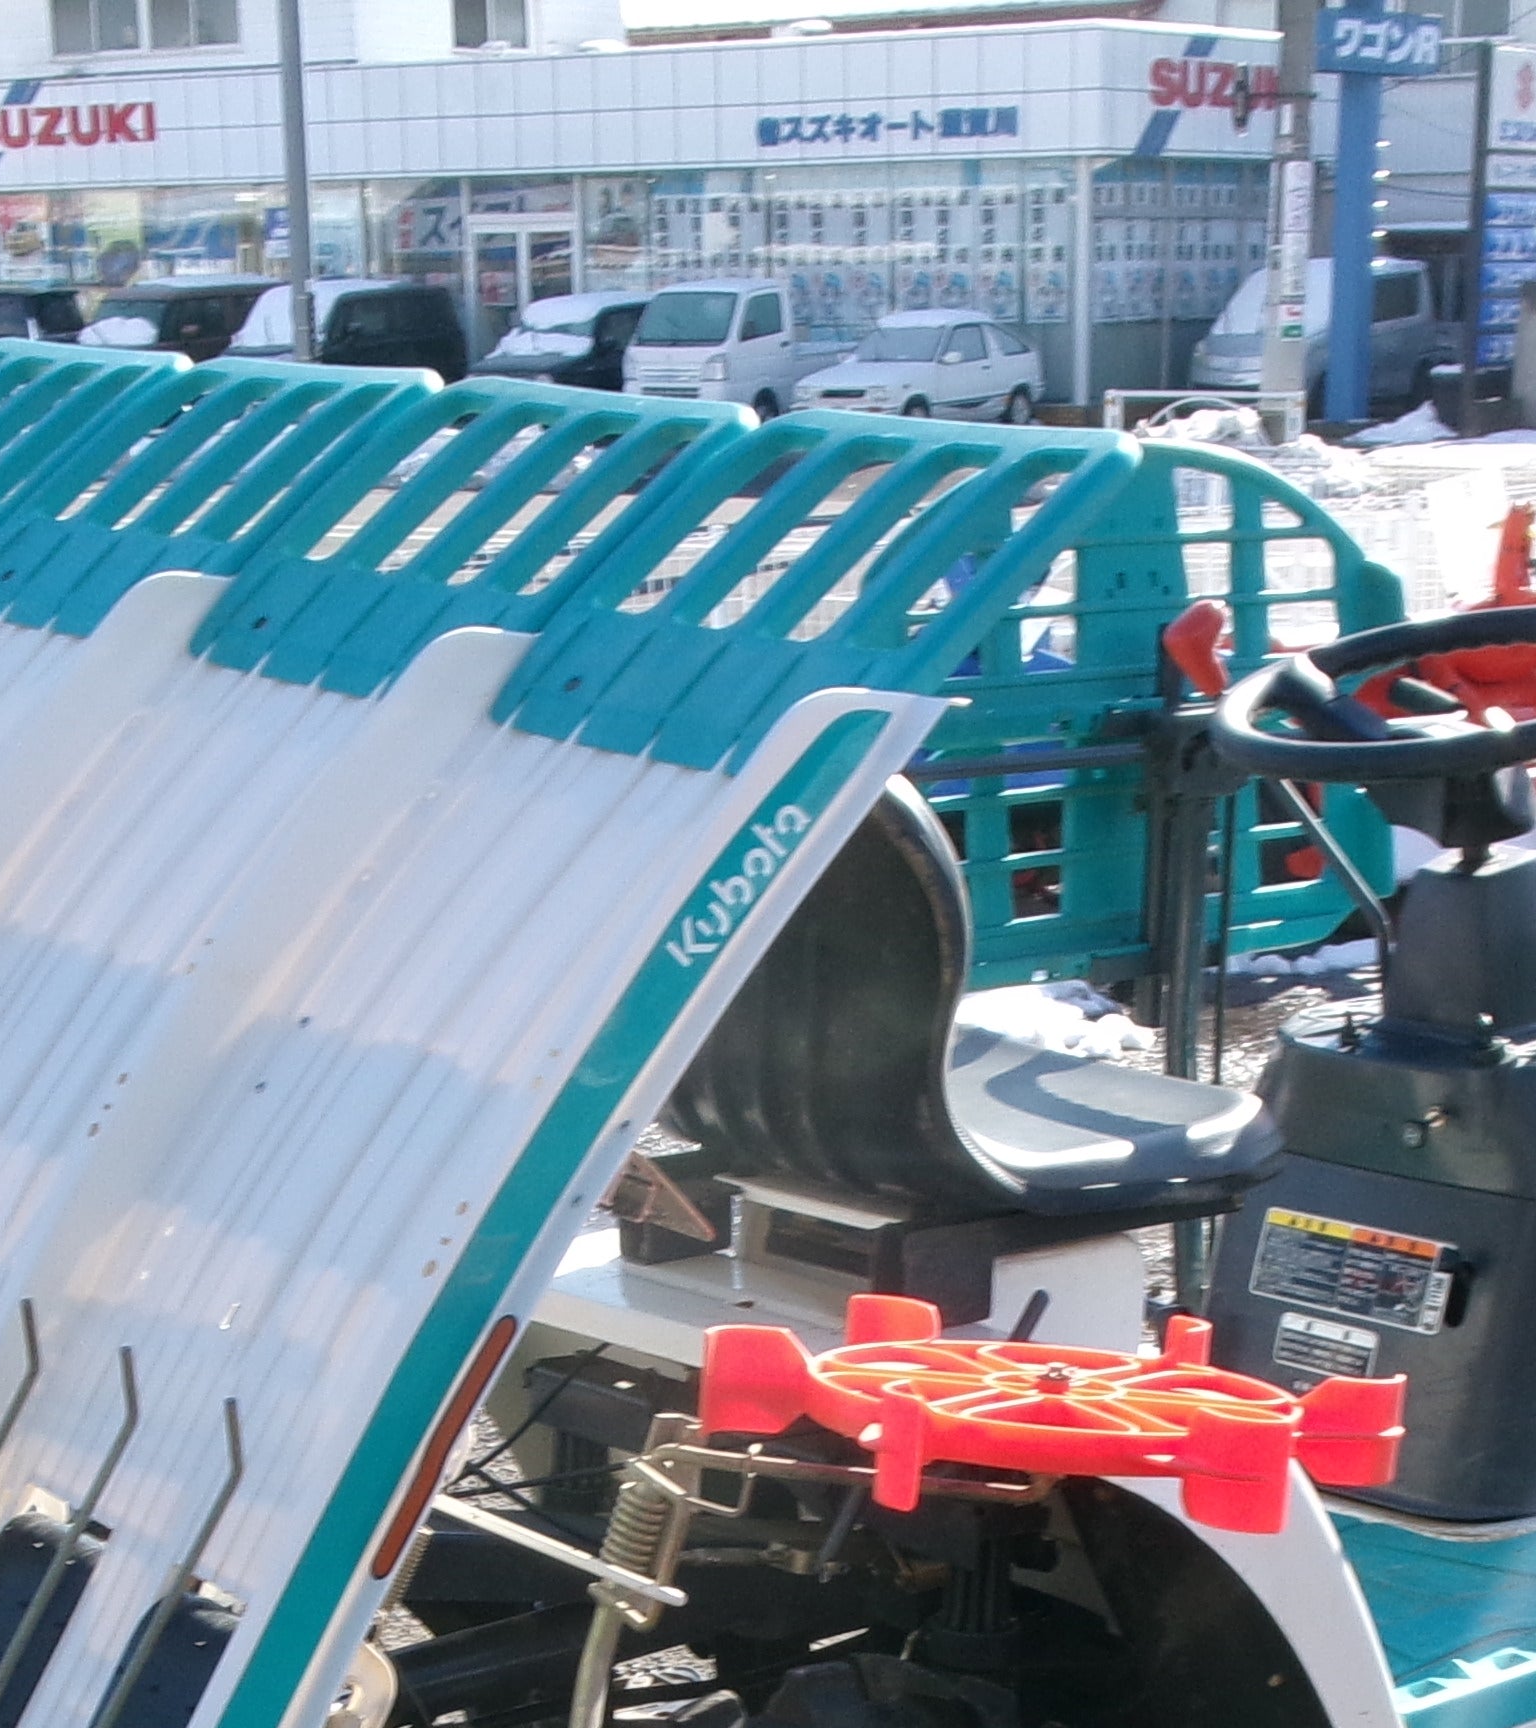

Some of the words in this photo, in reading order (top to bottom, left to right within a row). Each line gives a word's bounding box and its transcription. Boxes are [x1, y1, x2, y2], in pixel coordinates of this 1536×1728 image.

[1333, 18, 1440, 65] ワゴンR
[1149, 57, 1280, 110] SUZUK
[665, 803, 812, 967] Kubota
